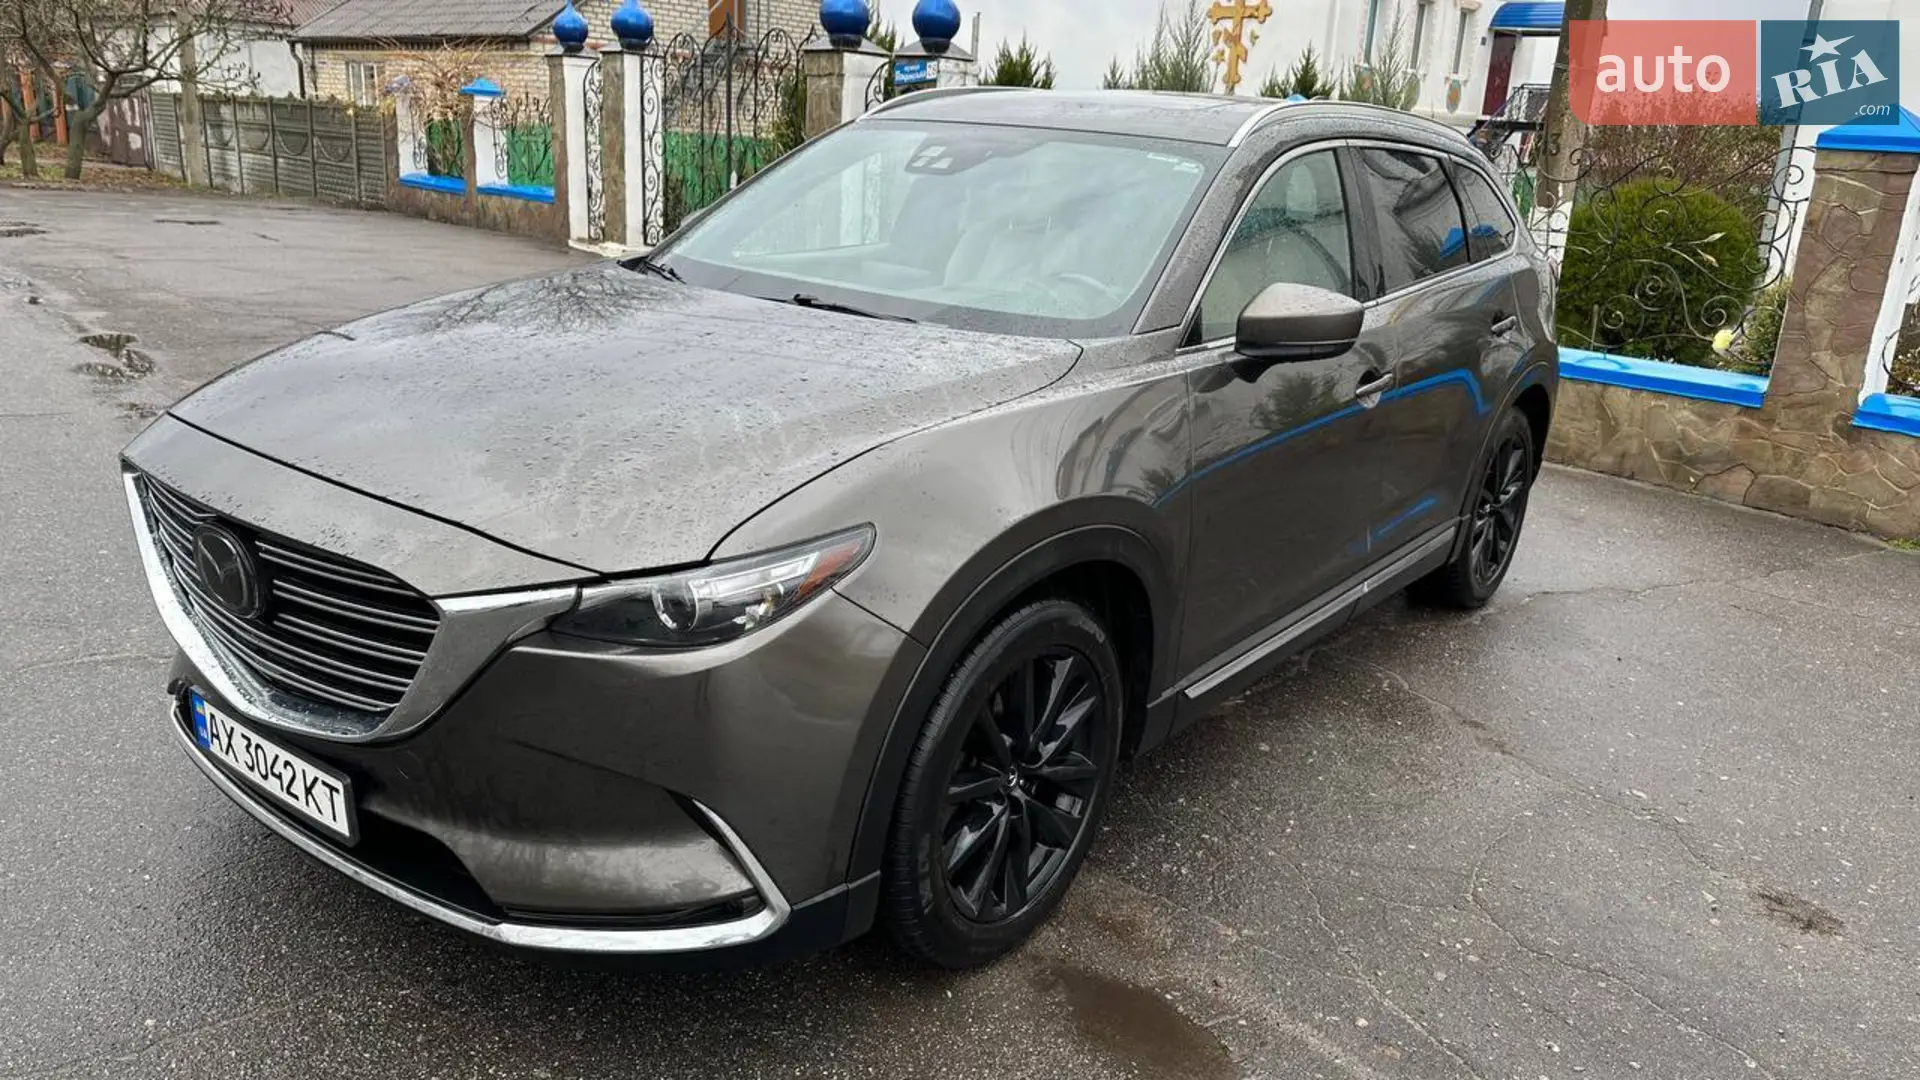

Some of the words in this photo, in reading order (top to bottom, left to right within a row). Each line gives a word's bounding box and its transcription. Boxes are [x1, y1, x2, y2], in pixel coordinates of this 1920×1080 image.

[209, 712, 239, 763] AX
[241, 732, 299, 801] 3042
[302, 768, 340, 822] KT
